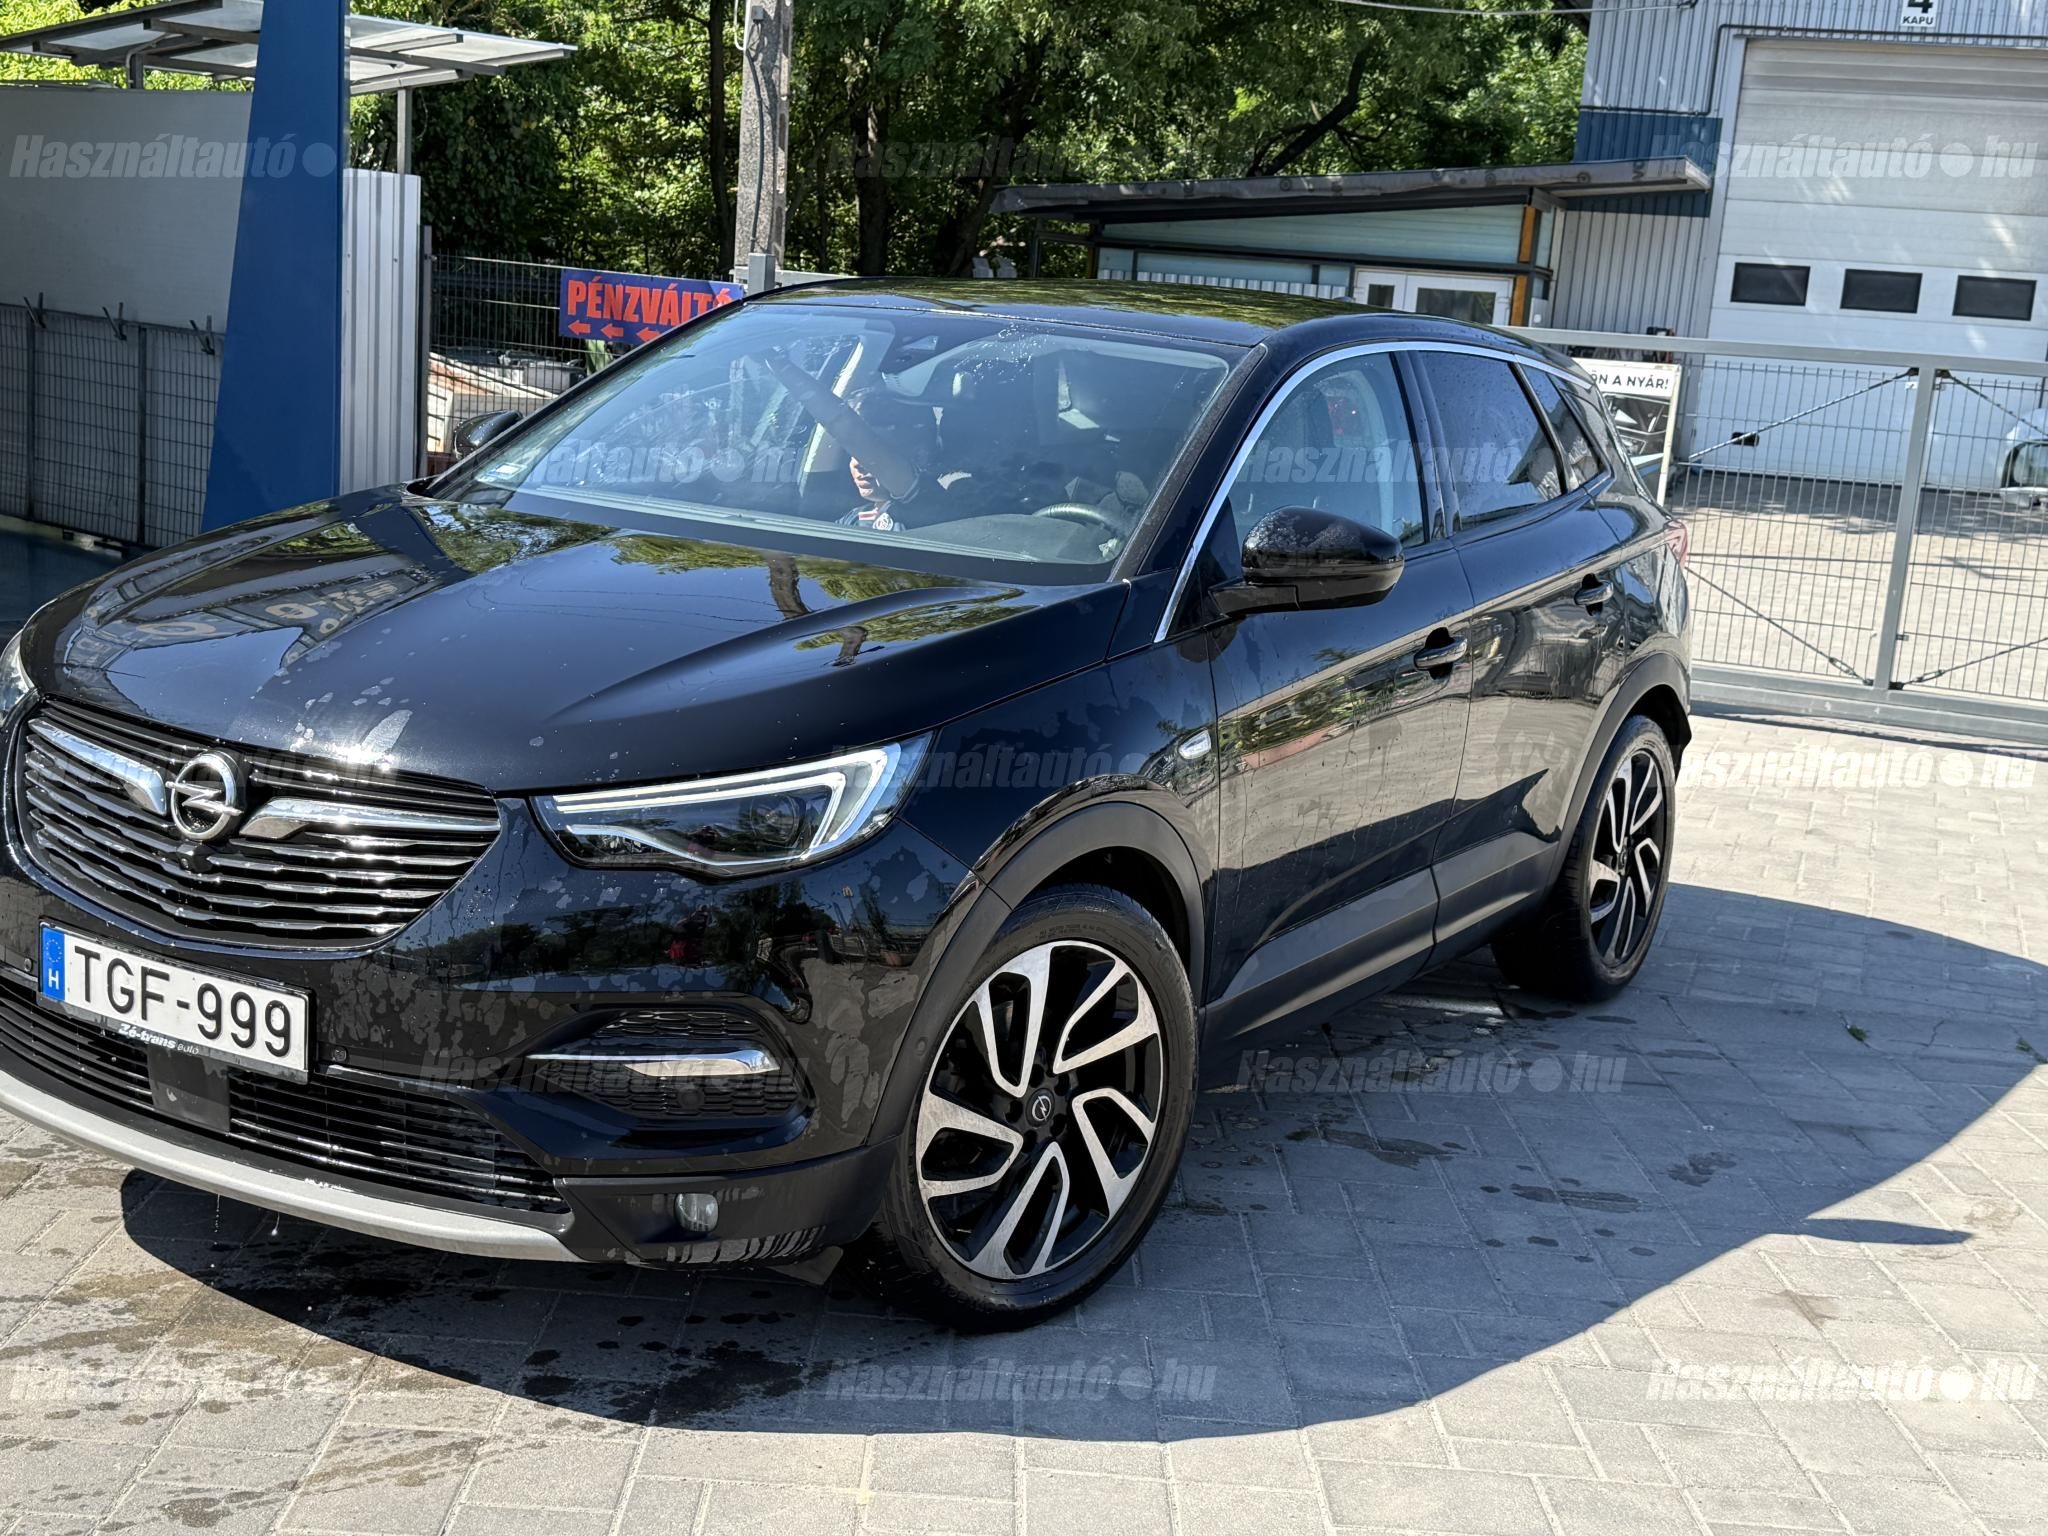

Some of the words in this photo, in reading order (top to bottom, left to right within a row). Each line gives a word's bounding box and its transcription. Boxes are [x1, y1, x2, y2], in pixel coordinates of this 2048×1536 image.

[1902, 16, 1934, 25] KAPU
[1591, 370, 1608, 385] ÖN
[1612, 375, 1622, 386] A
[1627, 374, 1669, 390] NYÁR!
[48, 968, 59, 990] H
[74, 945, 291, 1058] TGF-999
[118, 1023, 177, 1049] Zé-trans
